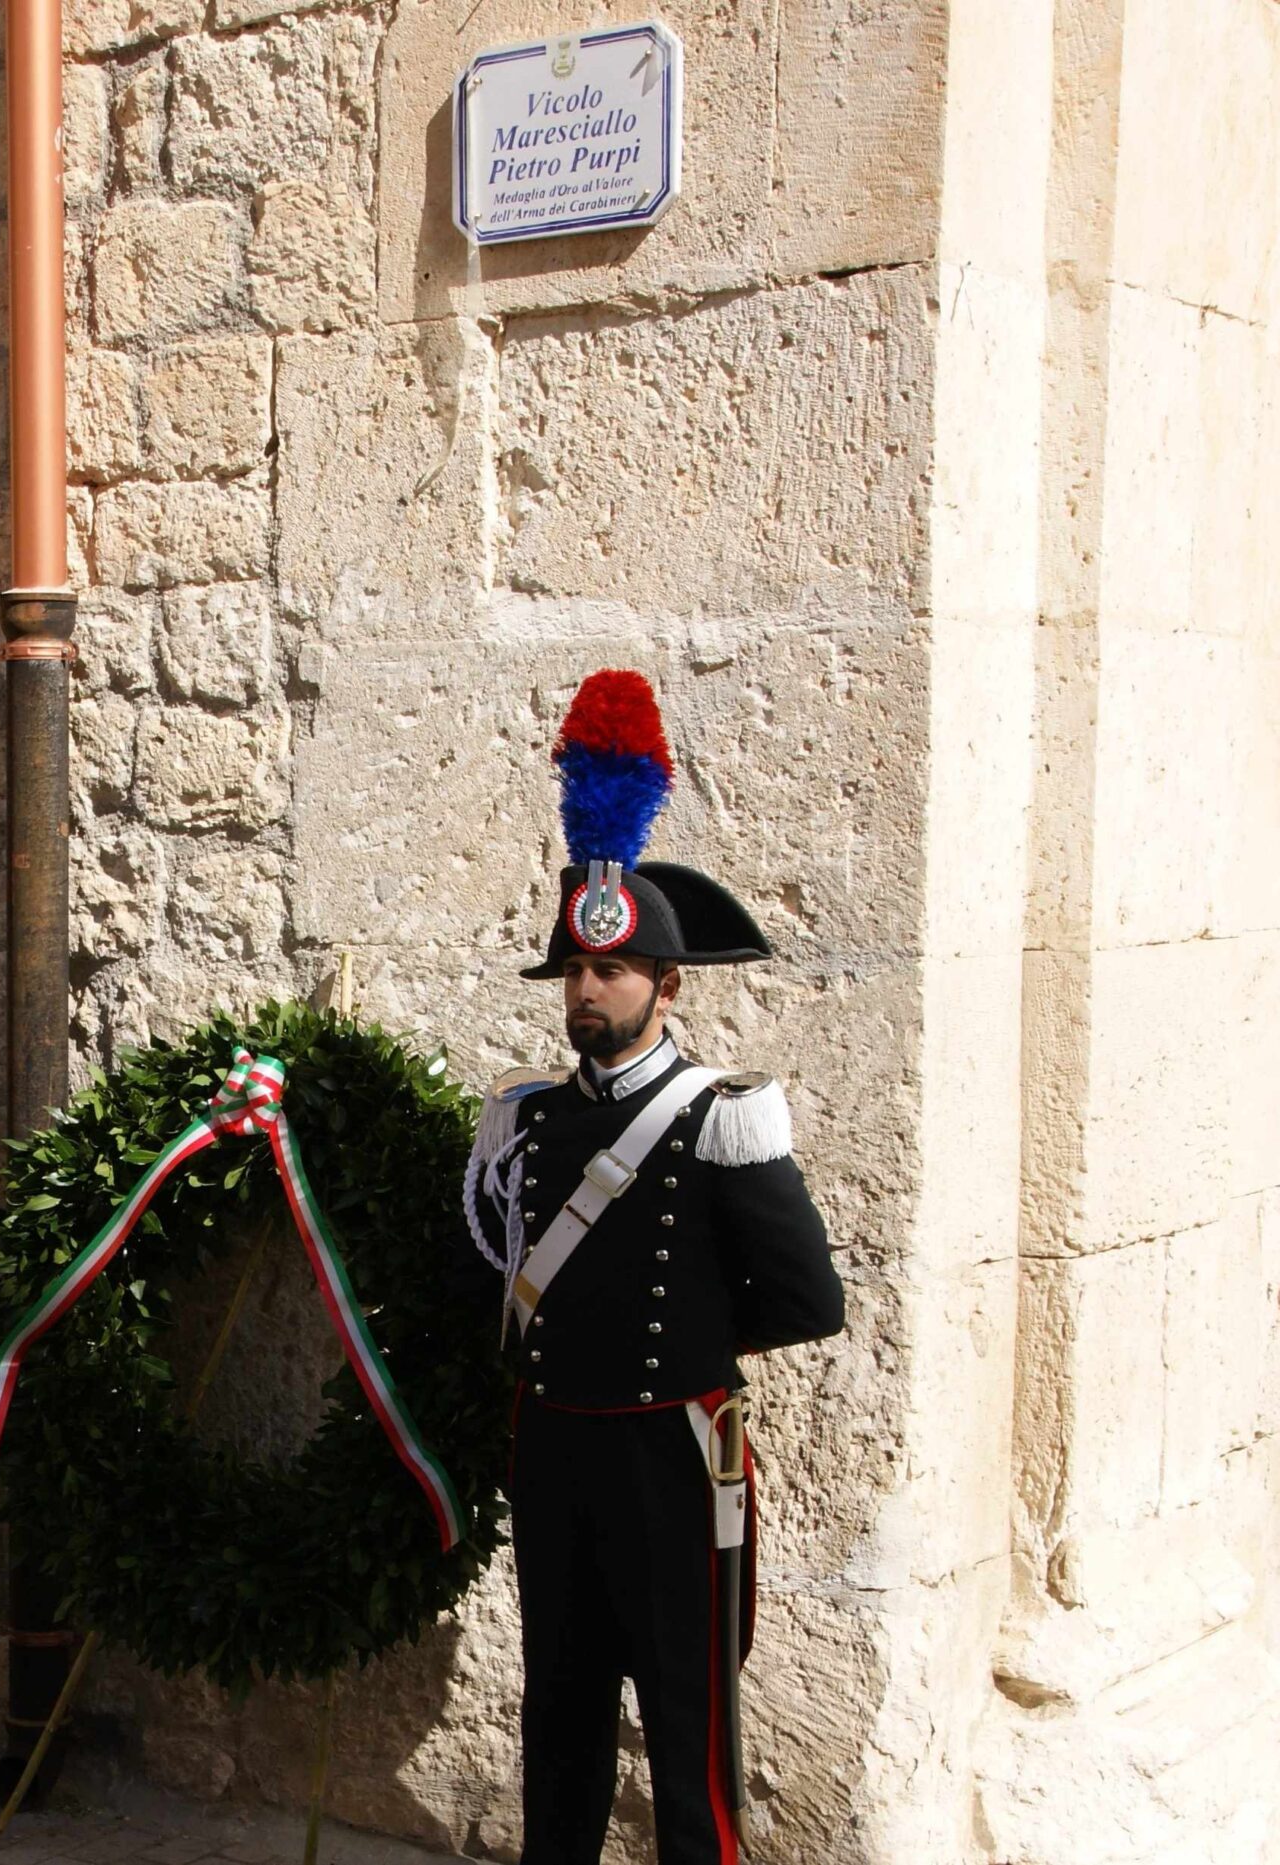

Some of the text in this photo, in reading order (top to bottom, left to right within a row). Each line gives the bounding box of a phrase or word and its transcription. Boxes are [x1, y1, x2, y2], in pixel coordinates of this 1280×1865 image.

[527, 85, 603, 117] Vicolo
[492, 109, 637, 152] Maresciallo
[488, 138, 641, 184] Pietro Purpi
[493, 176, 634, 205] Medaglia d'Oro al Valore
[549, 202, 566, 216] dei
[569, 194, 636, 213] Carabinieri
